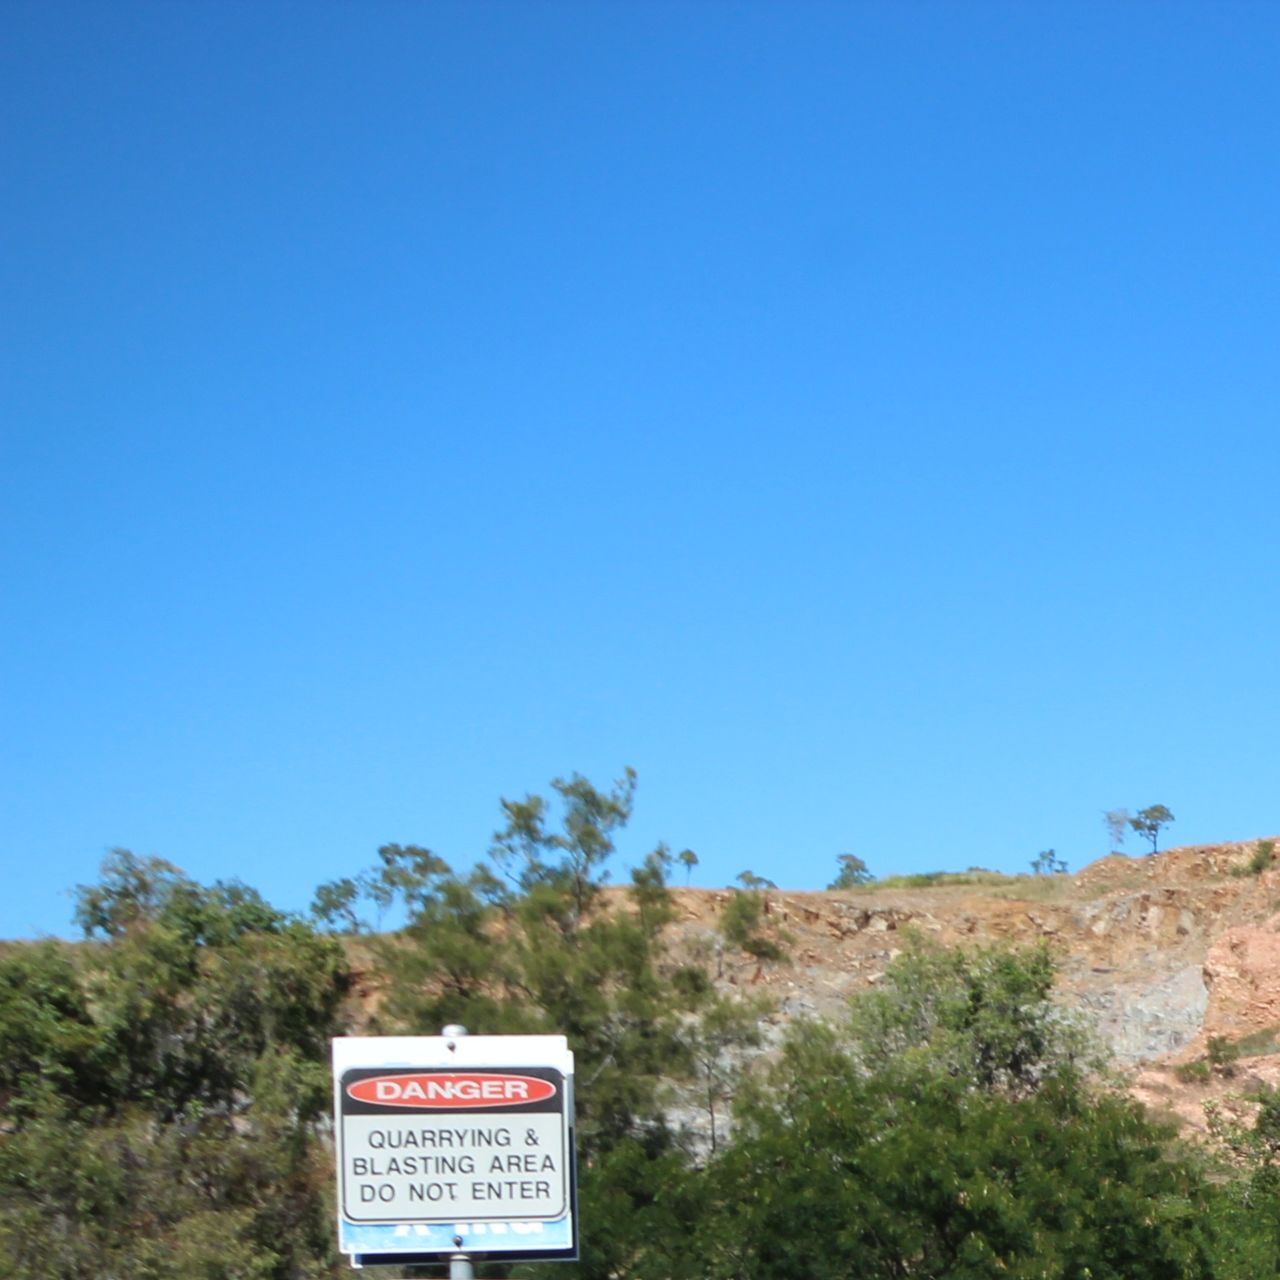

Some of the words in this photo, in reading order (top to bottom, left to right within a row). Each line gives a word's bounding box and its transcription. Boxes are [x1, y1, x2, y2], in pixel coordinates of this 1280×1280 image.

[375, 1081, 529, 1100] DANGER
[368, 1128, 511, 1149] QUARRYING
[524, 1128, 540, 1146] &
[353, 1155, 475, 1176] BLASTING
[489, 1154, 556, 1173] AREA
[360, 1183, 395, 1202] DO
[409, 1182, 458, 1201] NOT
[472, 1180, 551, 1200] ENTER
